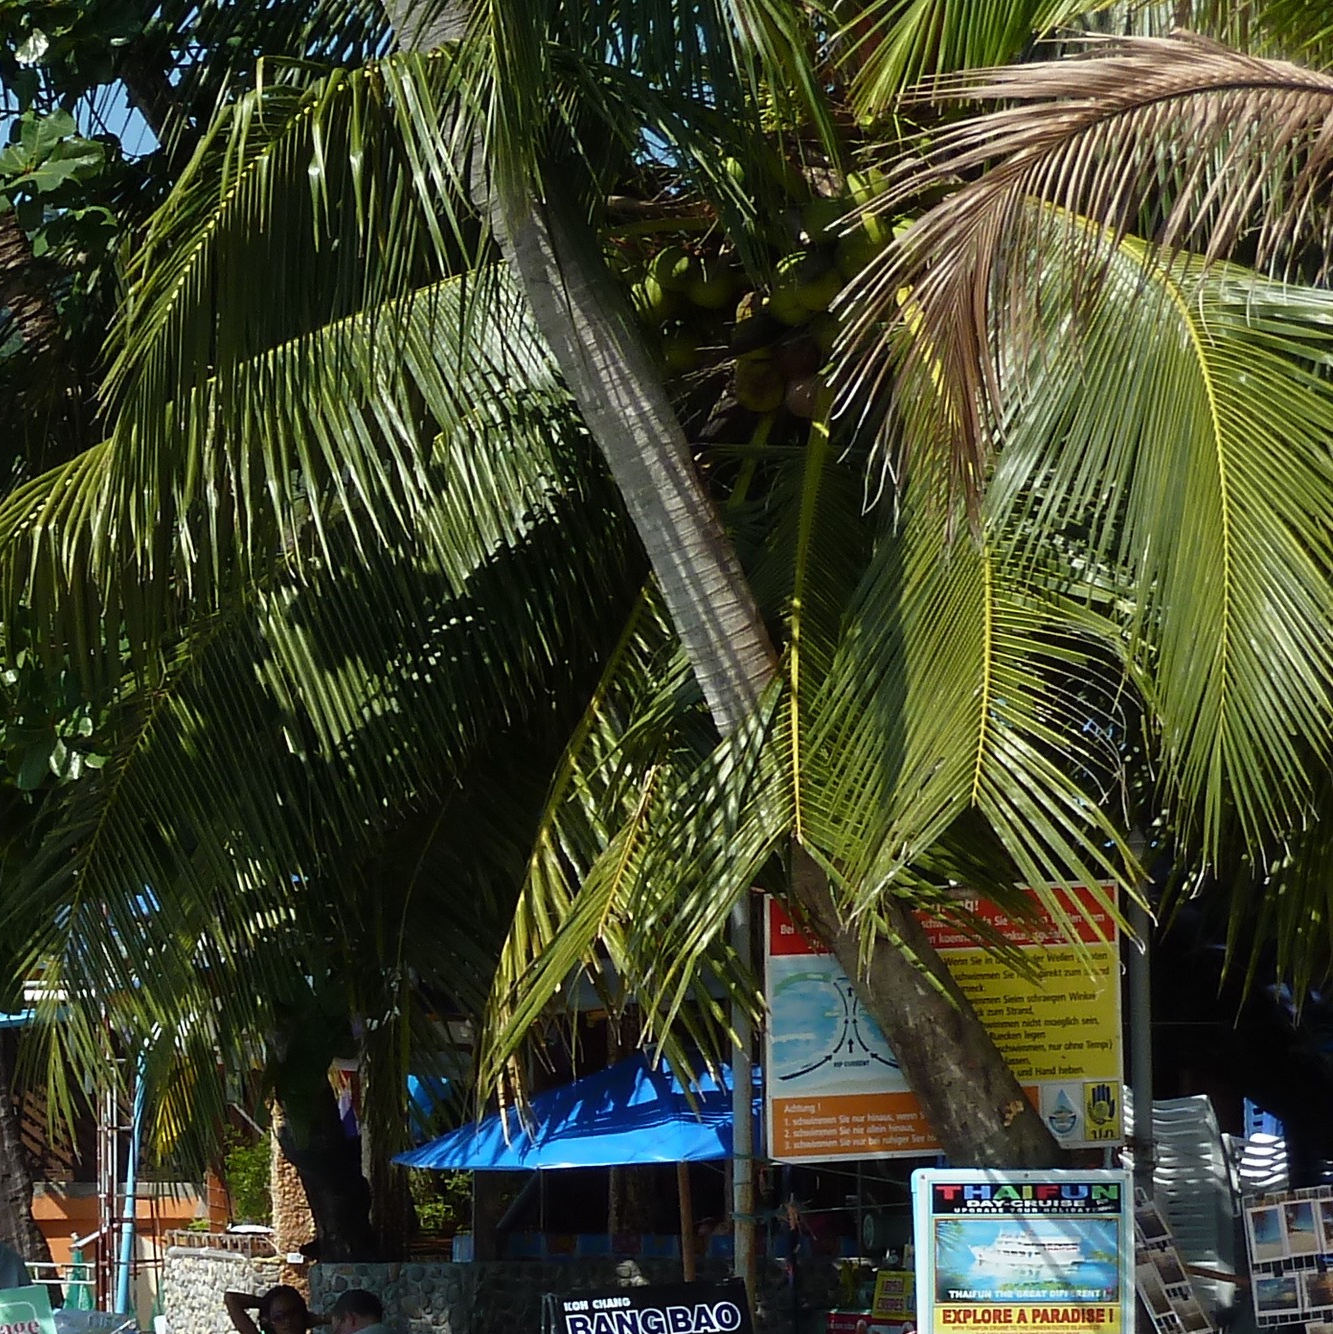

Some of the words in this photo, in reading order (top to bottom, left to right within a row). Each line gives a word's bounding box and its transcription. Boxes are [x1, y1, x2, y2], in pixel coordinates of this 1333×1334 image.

[970, 956, 982, 966] Sie
[1035, 1065, 1056, 1076] Hand
[935, 1185, 1119, 1200] THAIFUN
[966, 1200, 1086, 1208] DAY-CRUISE
[948, 1289, 992, 1300] THAIFUN
[563, 1300, 588, 1312] KOH
[592, 1297, 631, 1309] CHANG
[942, 1308, 1013, 1325] EXPLORE
[1016, 1308, 1028, 1324] A
[1031, 1307, 1106, 1324] PARADISE
